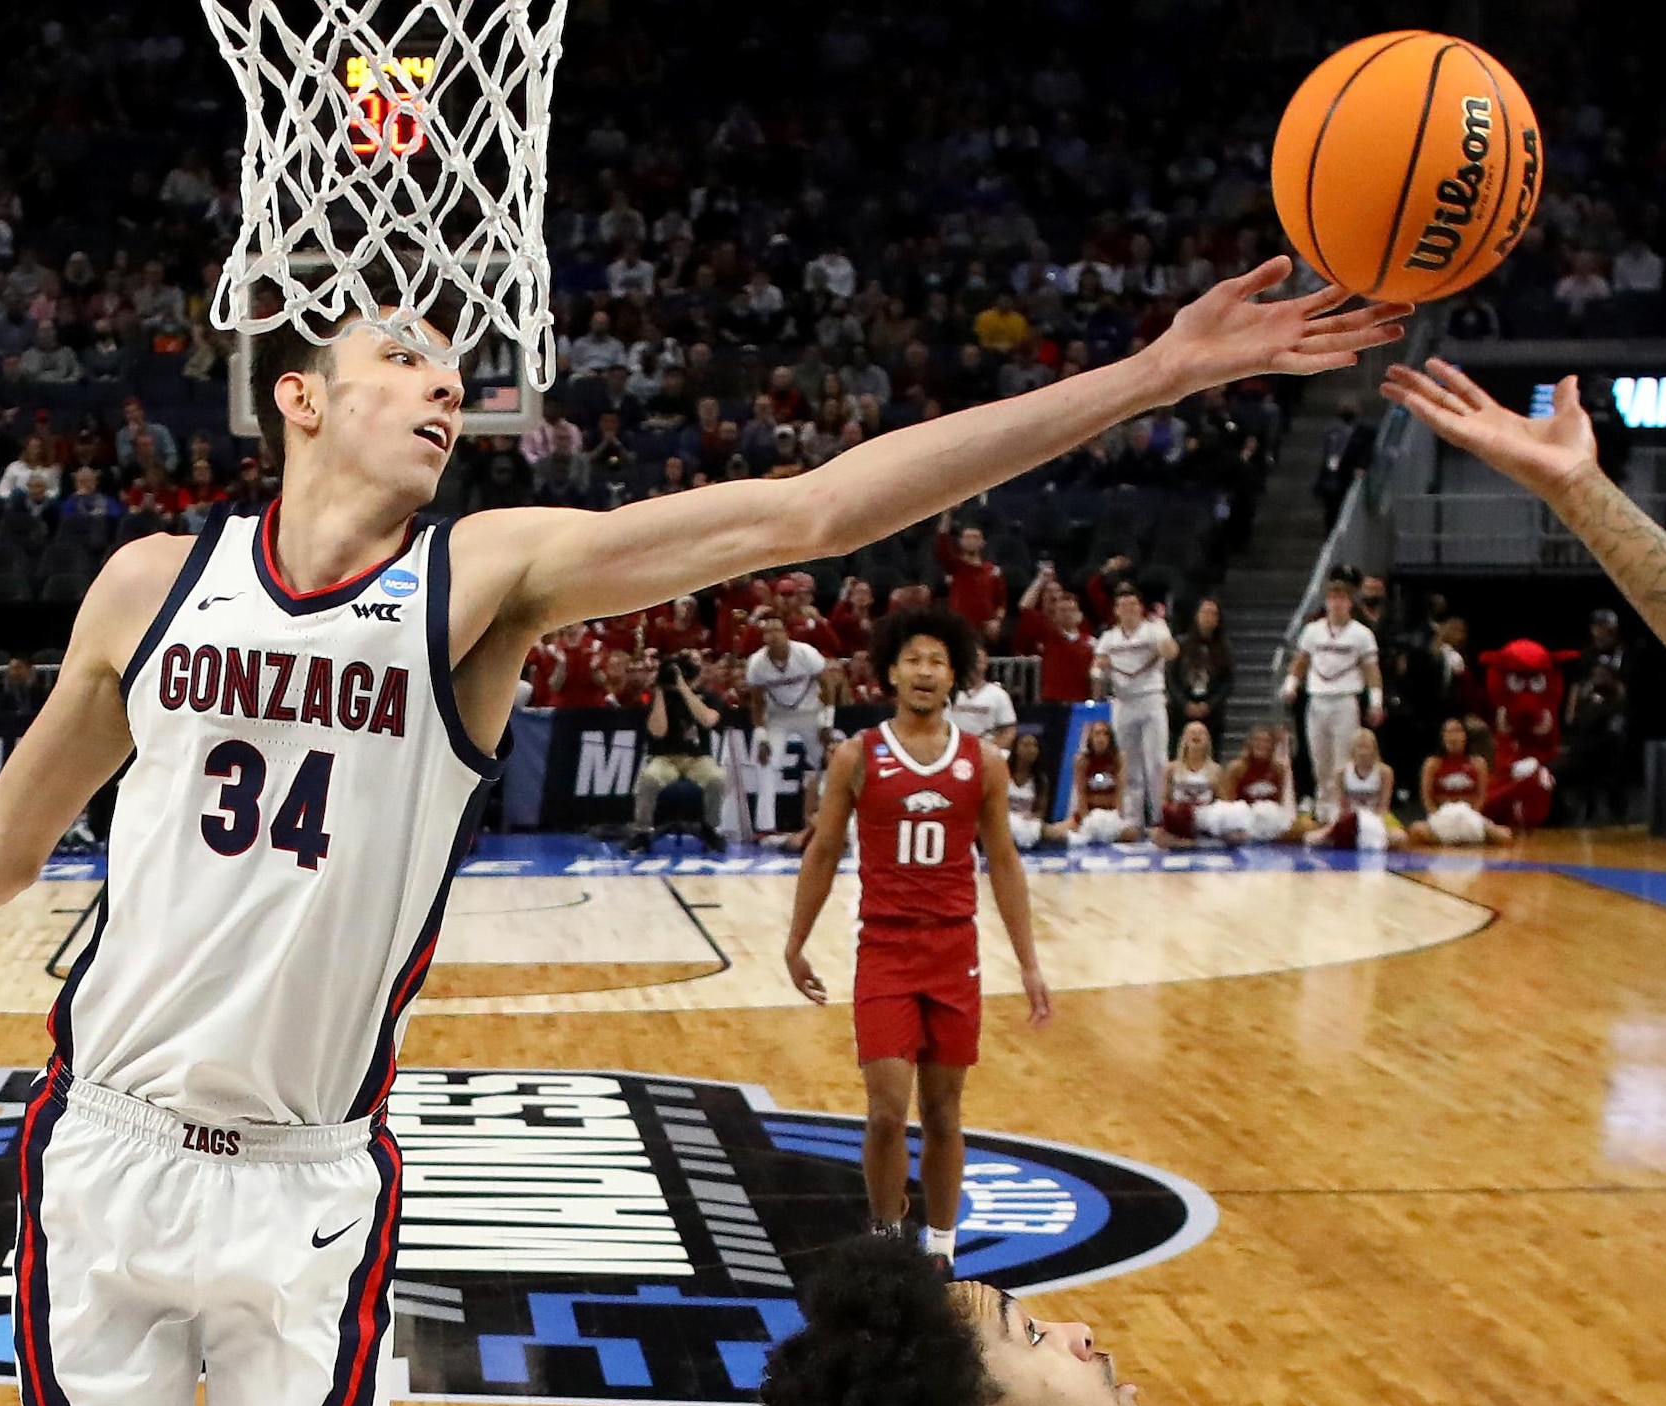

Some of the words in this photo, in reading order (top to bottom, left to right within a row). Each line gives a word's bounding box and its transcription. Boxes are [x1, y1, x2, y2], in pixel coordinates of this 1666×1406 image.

[1404, 95, 1493, 273] Wilson
[351, 602, 403, 623] WCC
[159, 642, 410, 738] GONZAGA
[200, 738, 336, 871] 34
[896, 819, 946, 867] 10
[182, 1122, 242, 1157] ZAGS
[387, 1072, 696, 1277] MADNESS
